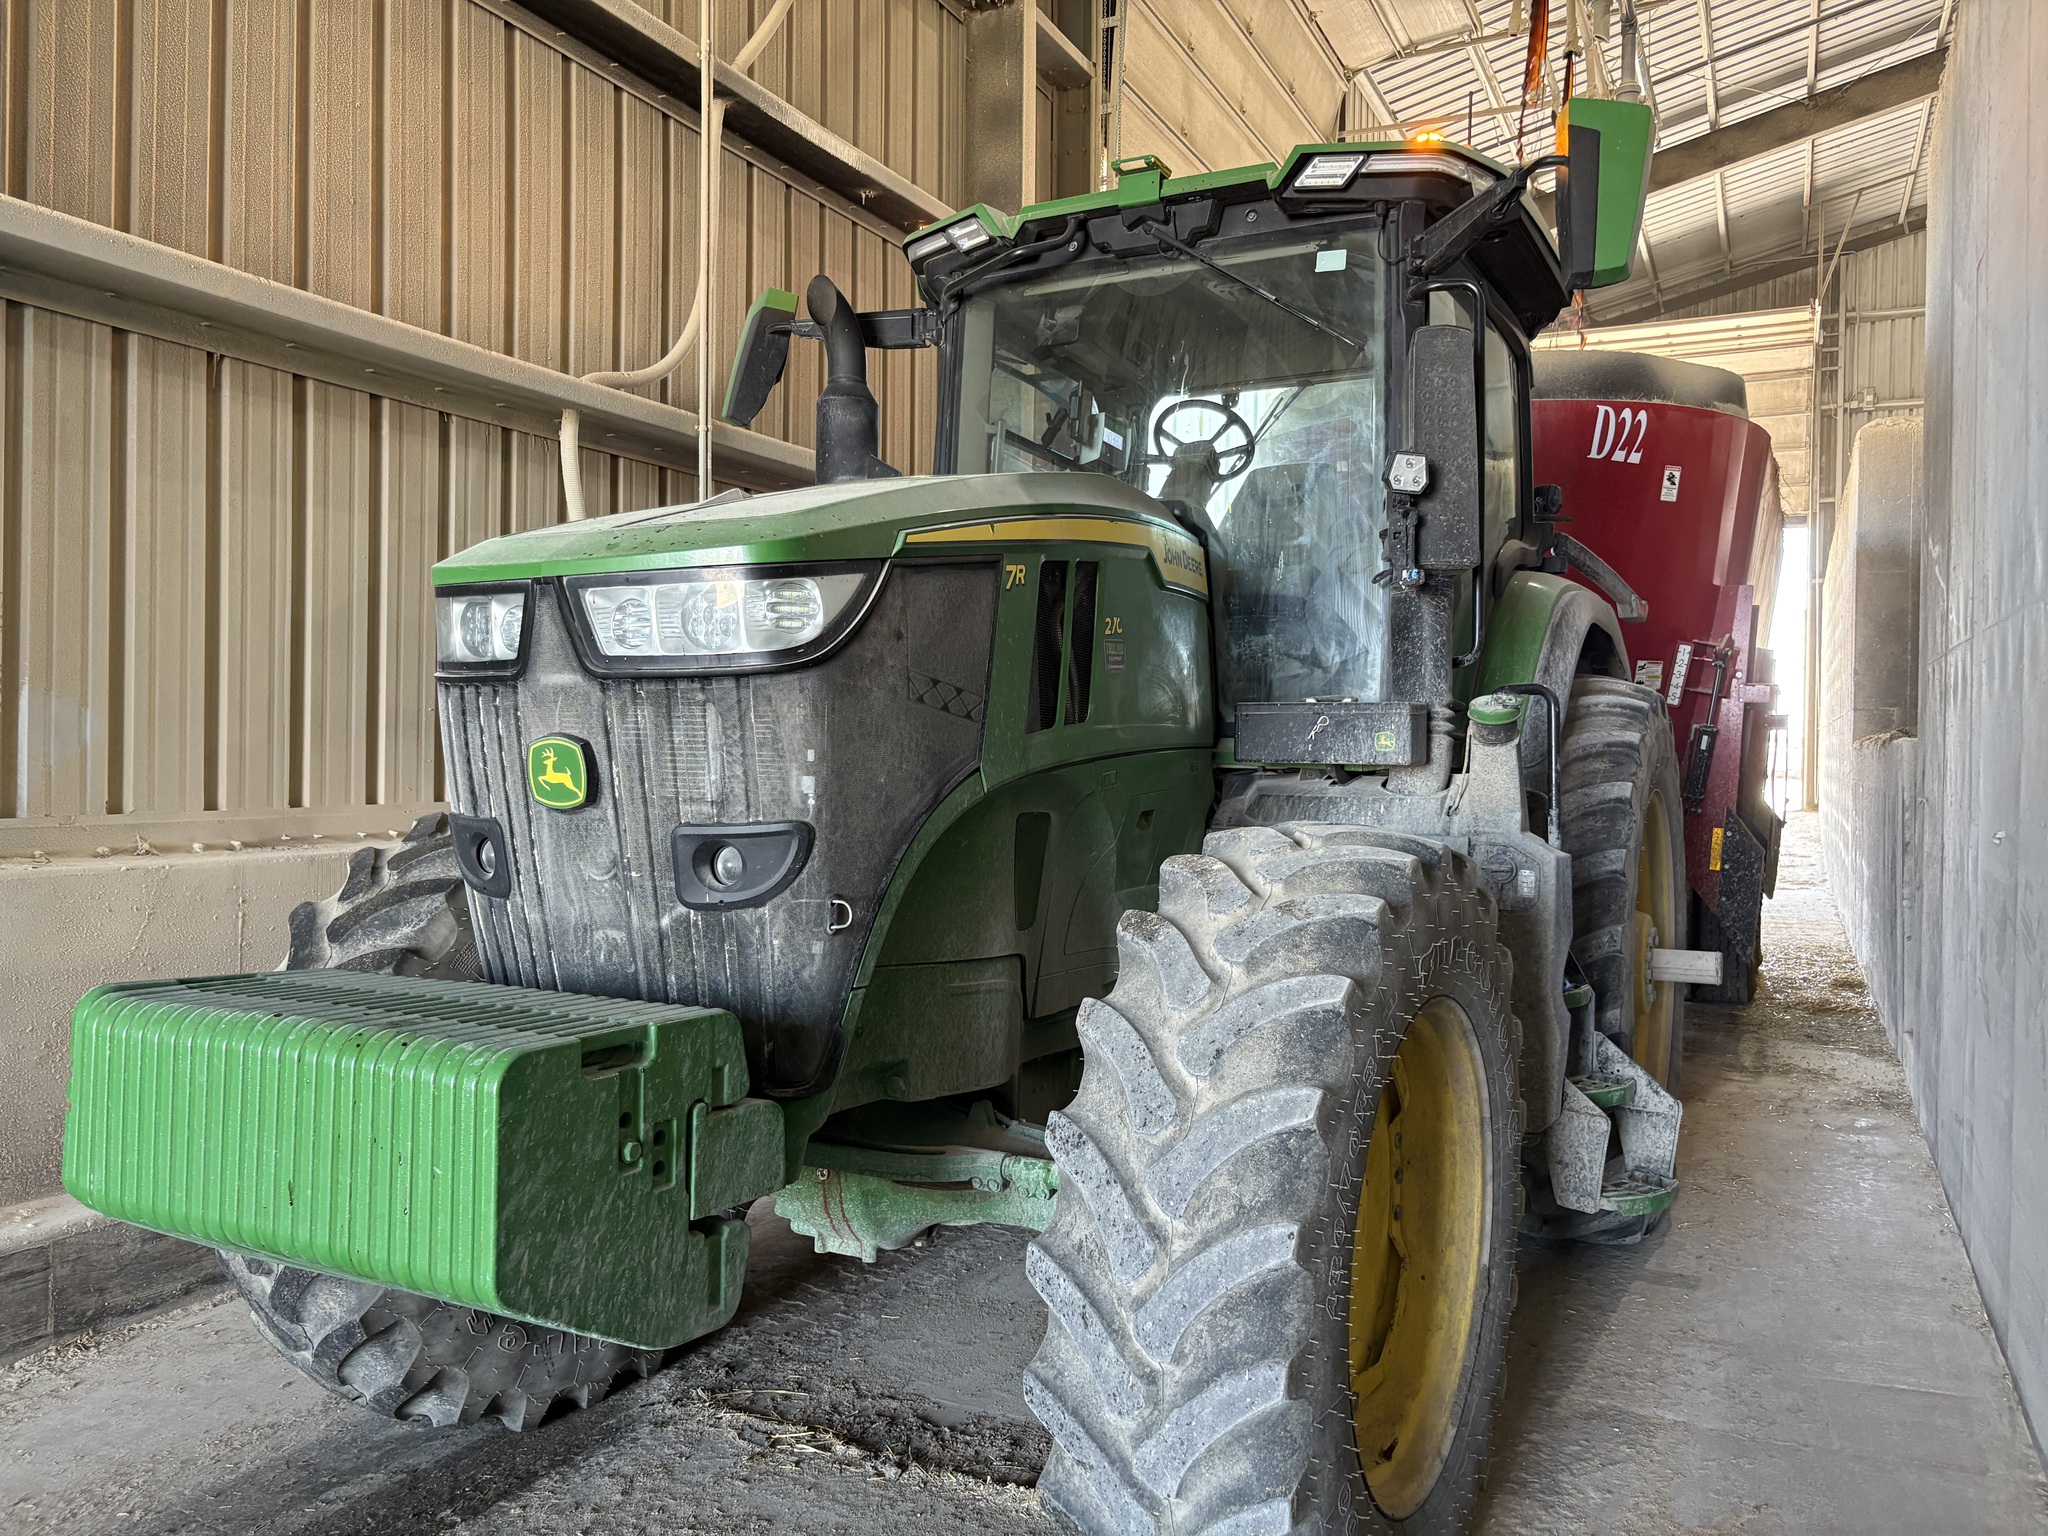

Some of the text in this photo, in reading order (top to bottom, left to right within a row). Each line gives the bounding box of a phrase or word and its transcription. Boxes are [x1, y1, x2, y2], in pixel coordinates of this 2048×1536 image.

[1587, 404, 1648, 465] D22
[1164, 543, 1203, 578] JOHN DEERE
[1005, 564, 1027, 590] 7R
[1678, 659, 1685, 668] 2
[1675, 671, 1682, 679] 3
[1670, 692, 1677, 701] 5
